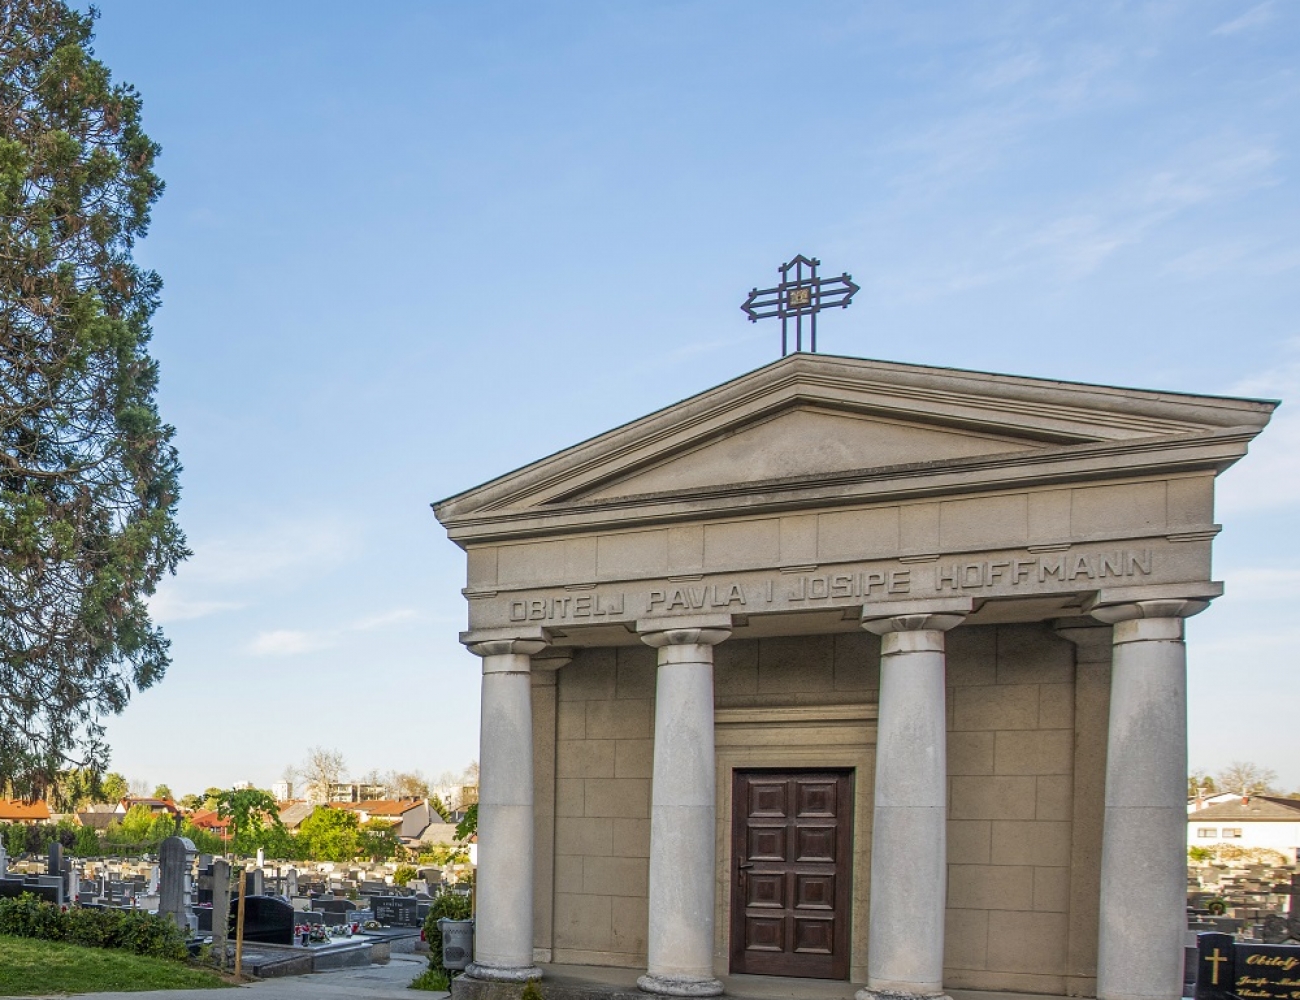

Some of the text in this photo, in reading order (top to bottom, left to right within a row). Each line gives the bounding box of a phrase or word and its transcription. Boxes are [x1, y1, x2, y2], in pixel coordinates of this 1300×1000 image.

[509, 549, 1152, 622] OBITELJ PAVLA I JOSIPE HOFFMANN
[1246, 954, 1300, 971] Obitelj
